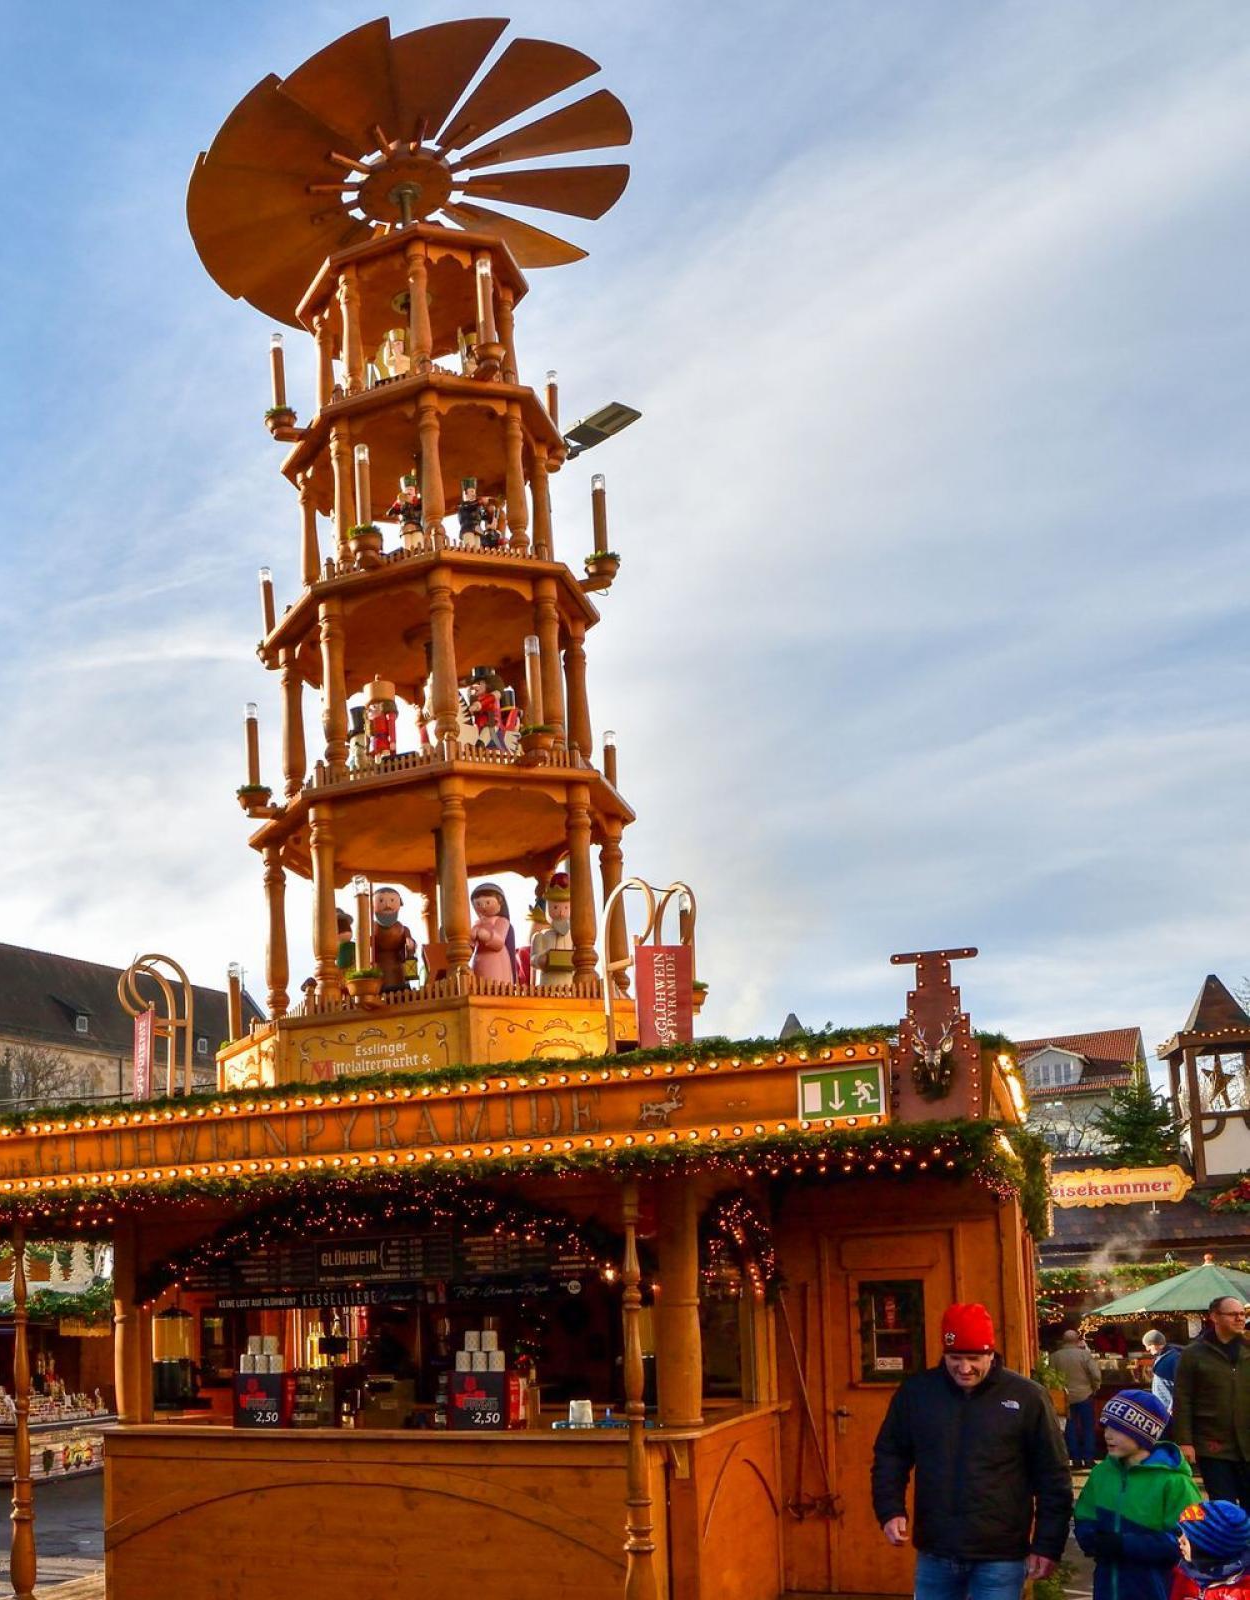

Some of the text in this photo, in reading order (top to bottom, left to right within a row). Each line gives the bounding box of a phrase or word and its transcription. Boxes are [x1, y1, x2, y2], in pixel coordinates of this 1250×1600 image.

[666, 953, 677, 1027] PYRAMIDE
[355, 1042, 407, 1057] Esslinger
[313, 1053, 430, 1080] Mittelaltermarkt &
[321, 1248, 378, 1267] GLÜHWEIN
